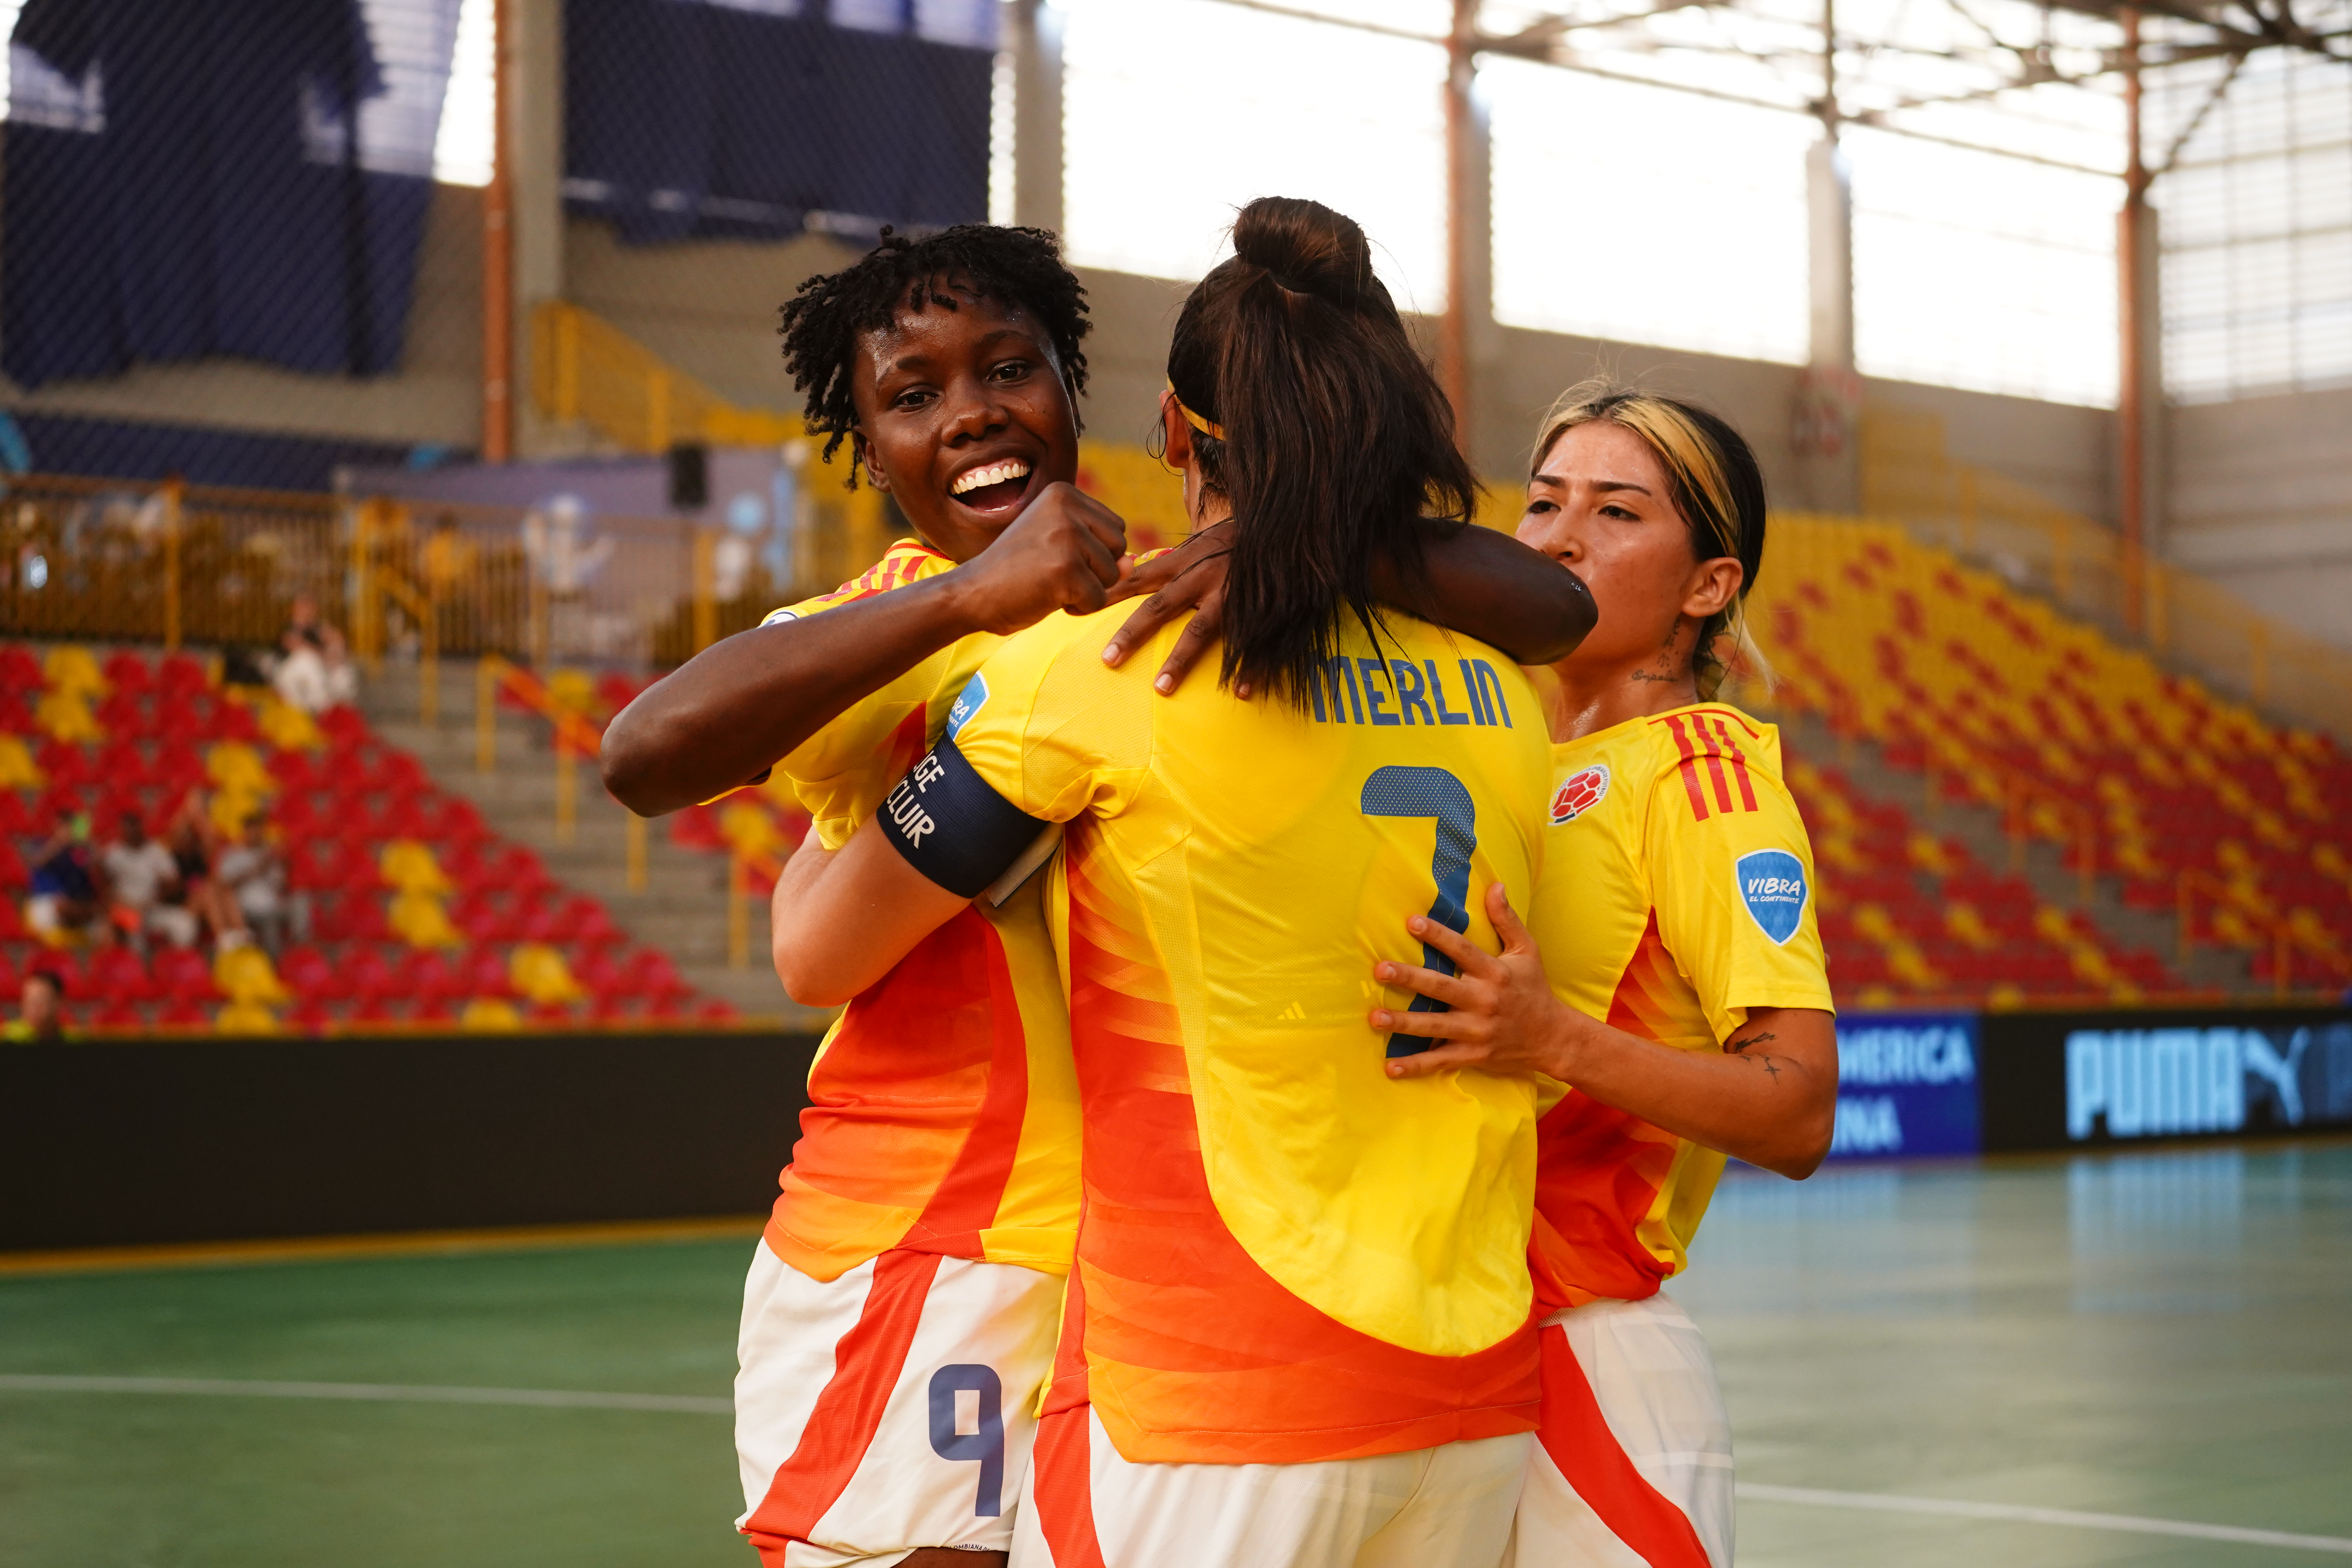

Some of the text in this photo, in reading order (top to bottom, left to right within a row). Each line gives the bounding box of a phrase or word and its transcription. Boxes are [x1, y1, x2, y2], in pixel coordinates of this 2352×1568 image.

[1309, 651, 1513, 728] MERLIN
[887, 775, 935, 849] CLUIR
[1361, 765, 1477, 1058] 7
[1748, 877, 1801, 896] VIBRA
[2065, 1026, 2244, 1140] PUMA
[929, 1364, 1005, 1517] 9
